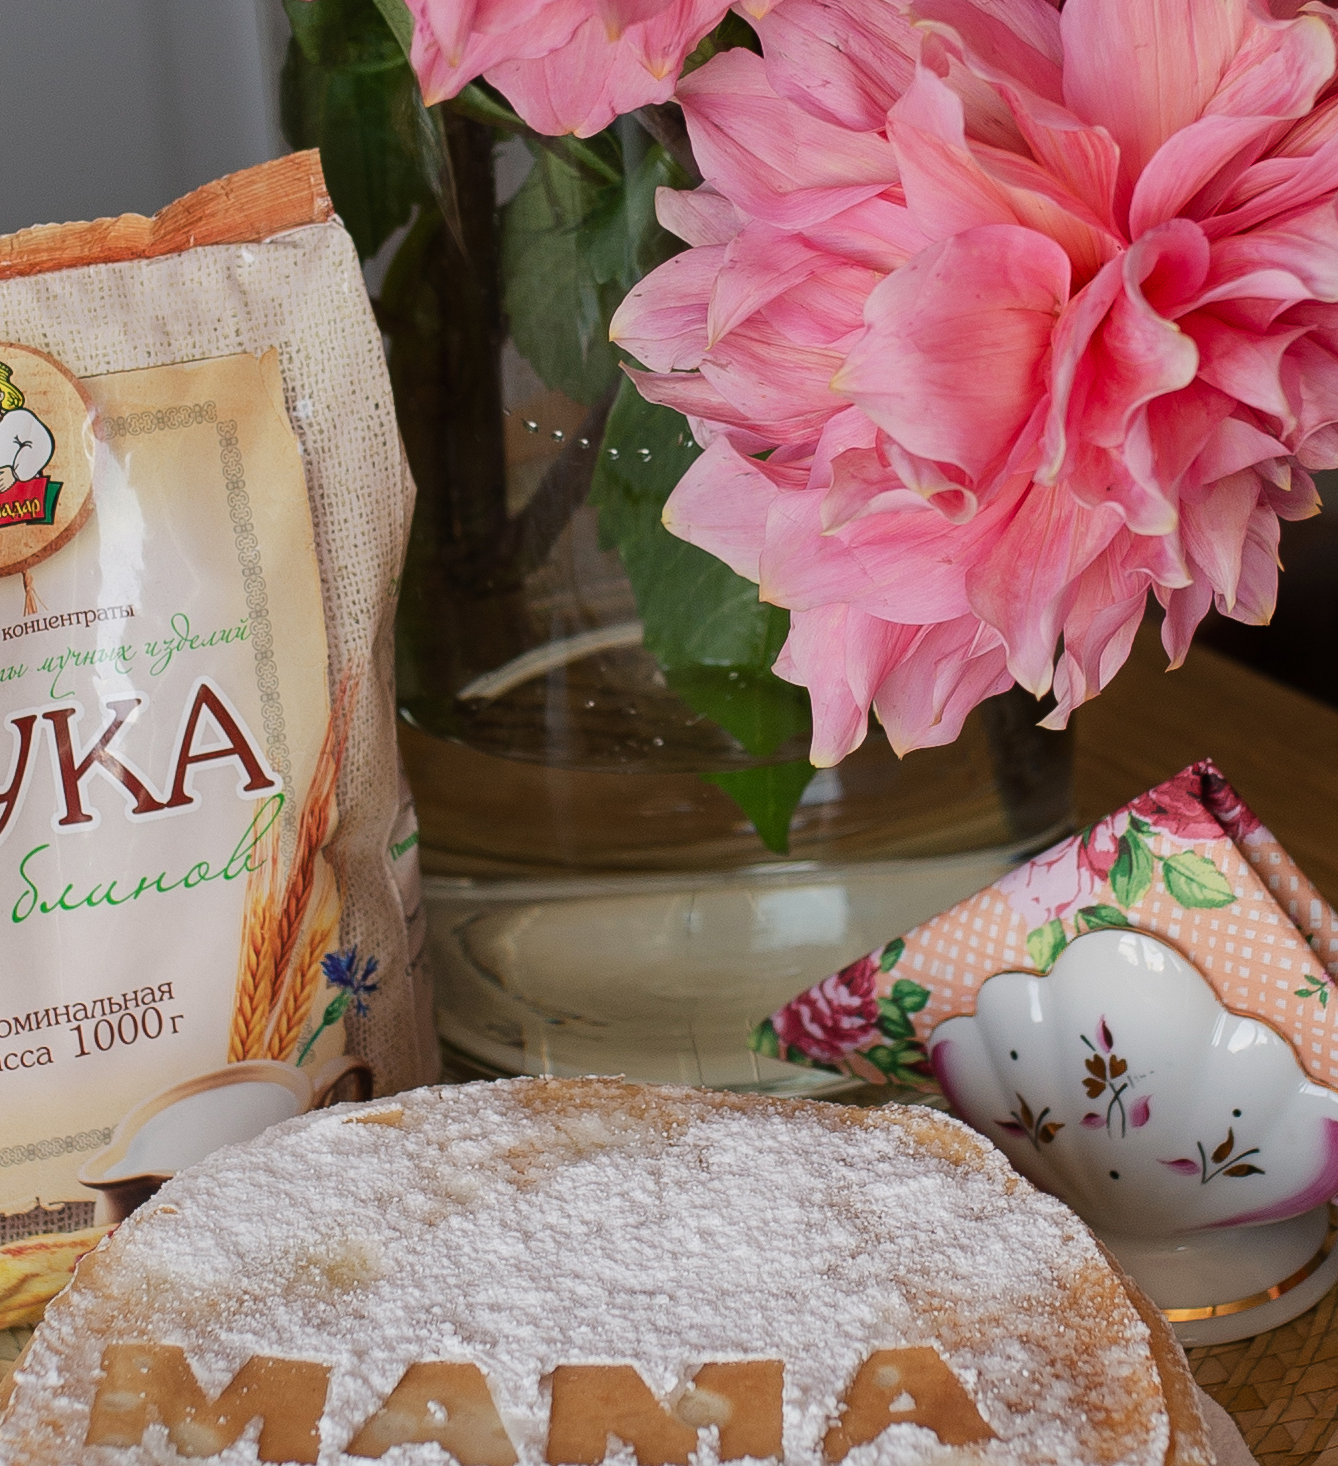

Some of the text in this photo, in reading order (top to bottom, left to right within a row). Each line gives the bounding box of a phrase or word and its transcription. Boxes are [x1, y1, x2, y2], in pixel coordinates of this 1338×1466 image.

[1, 604, 136, 643] концентраты
[37, 643, 138, 700] мучных
[143, 612, 253, 676] изделий
[10, 792, 286, 923] блинов
[72, 1004, 165, 1059] 1000
[169, 1009, 185, 1036] г
